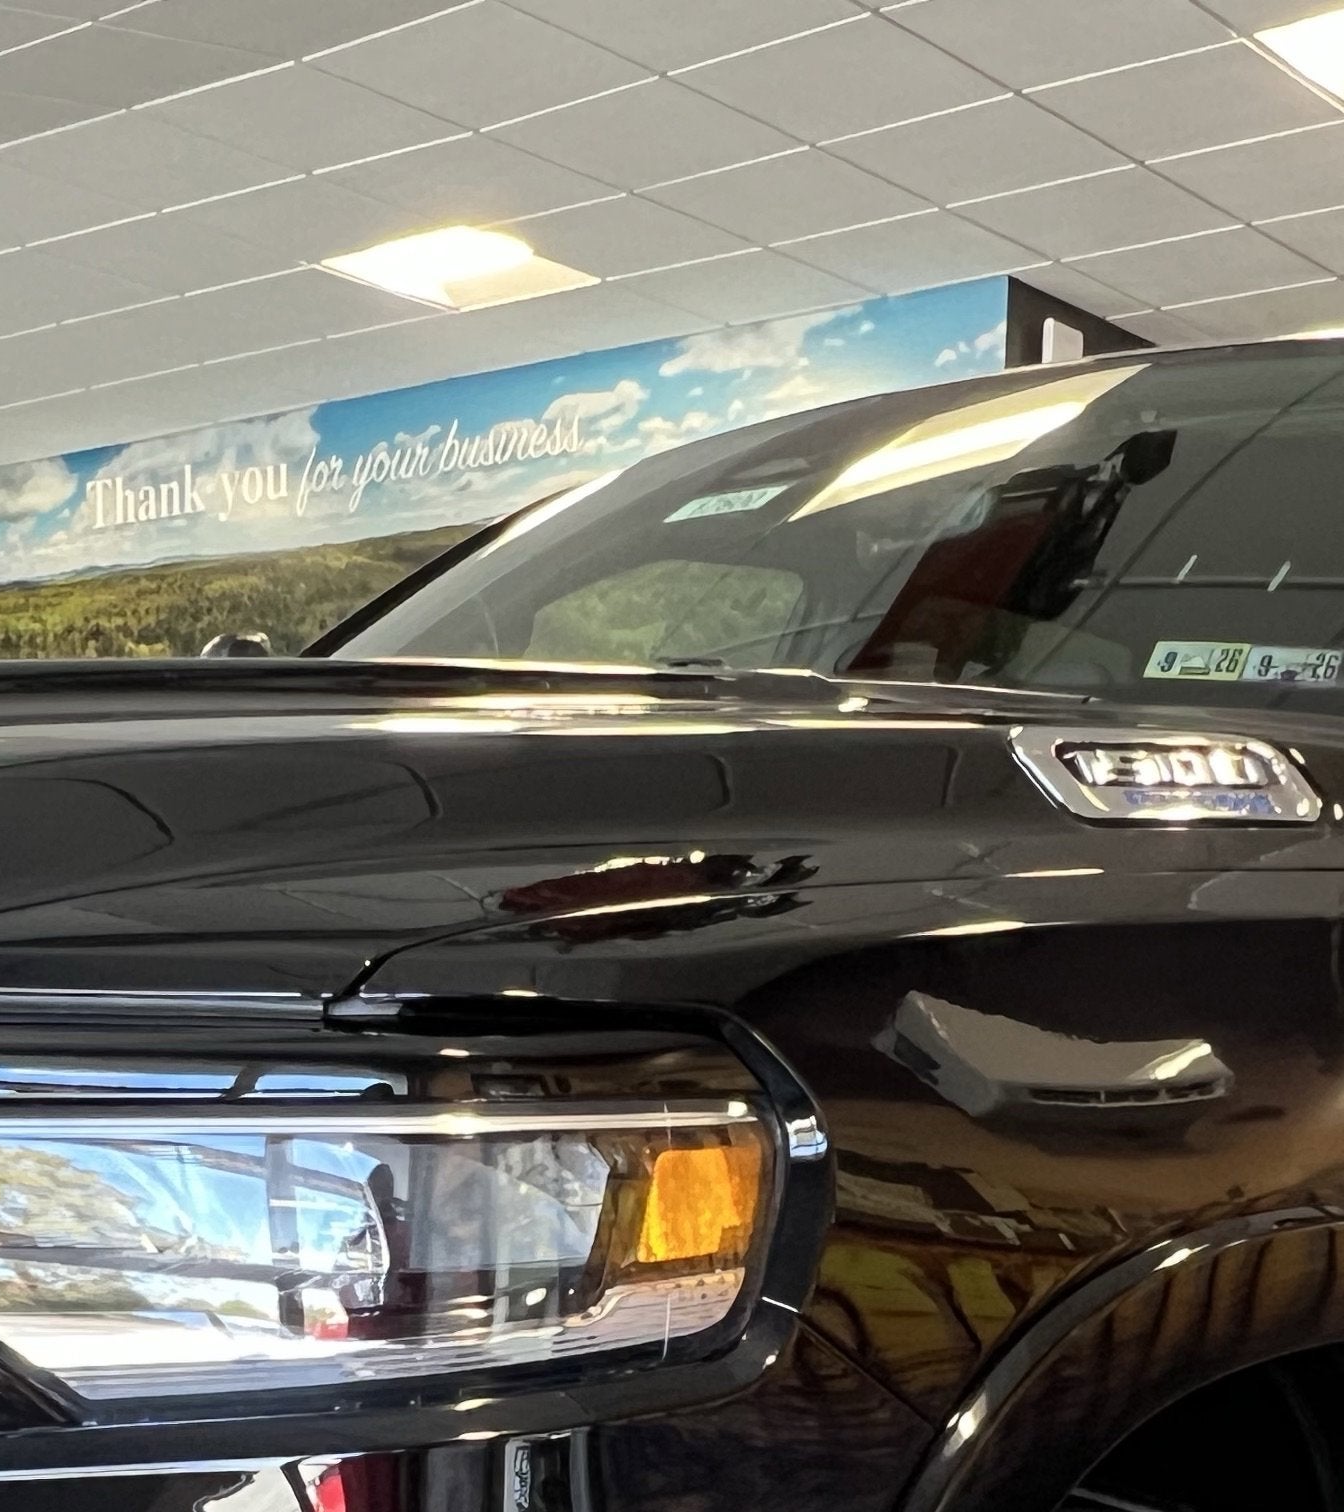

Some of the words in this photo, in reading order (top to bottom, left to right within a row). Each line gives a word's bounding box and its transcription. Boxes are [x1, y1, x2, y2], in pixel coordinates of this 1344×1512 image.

[85, 464, 207, 530] Thank
[217, 461, 289, 522] you
[296, 442, 345, 518] for
[351, 440, 438, 513] your
